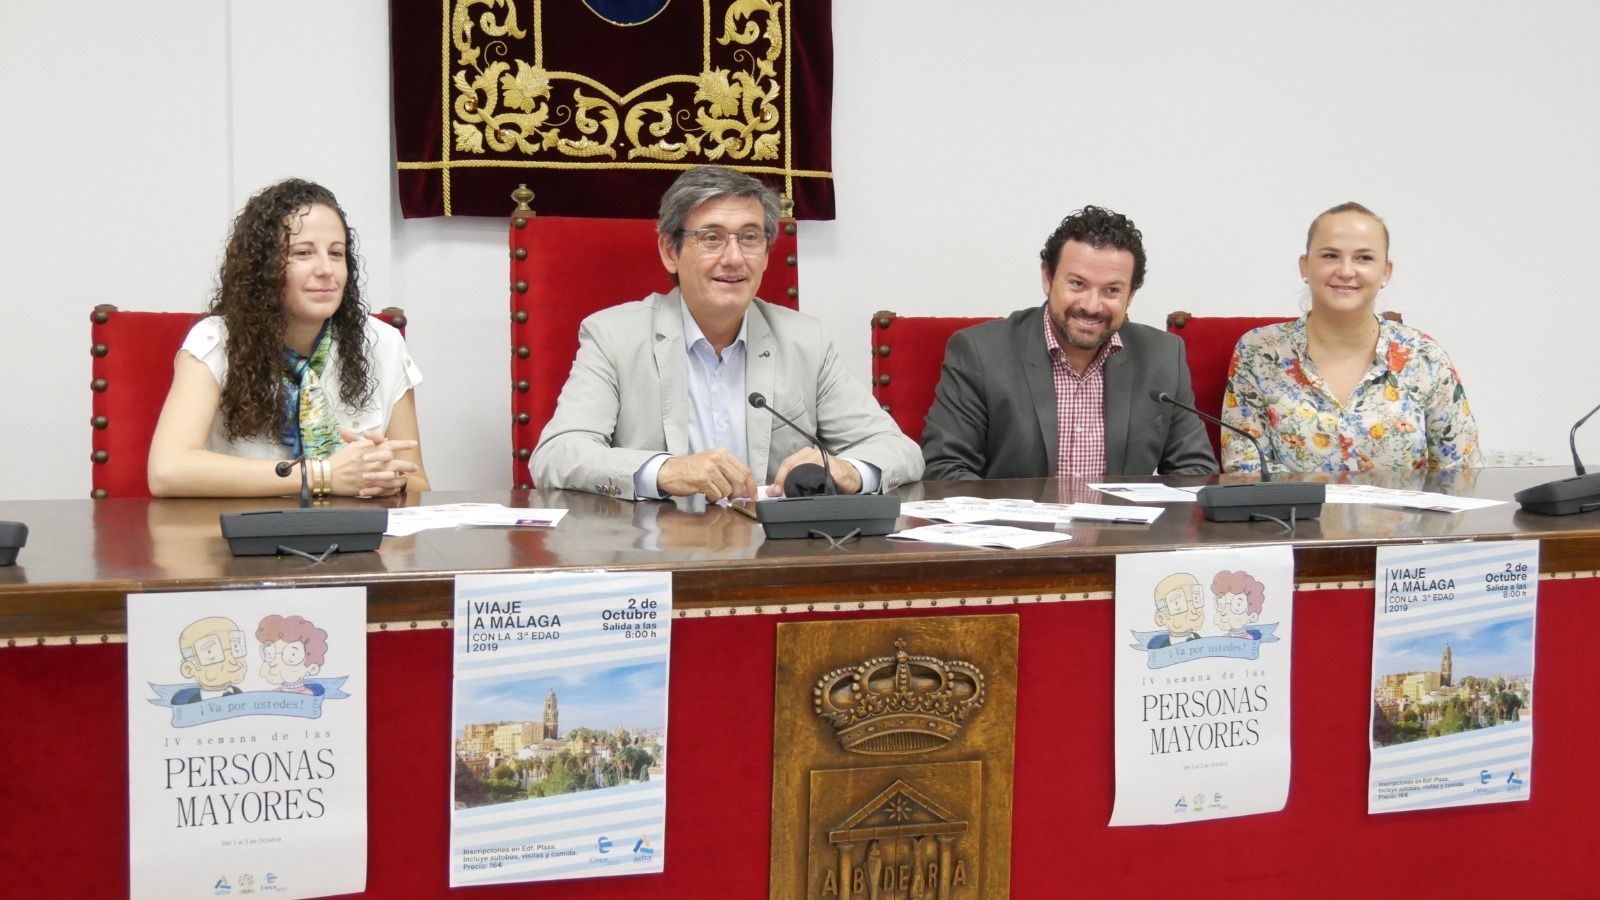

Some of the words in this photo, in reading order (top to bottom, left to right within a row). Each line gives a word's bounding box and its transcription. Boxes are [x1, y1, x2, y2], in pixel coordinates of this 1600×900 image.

[1391, 567, 1426, 580] VIAJE
[1505, 562, 1512, 573] 2
[1515, 563, 1528, 572] de
[1485, 572, 1527, 583] Octubre
[1390, 582, 1399, 593] A
[1402, 577, 1455, 593] MÁLAGA
[1486, 584, 1509, 592] Salida
[1389, 596, 1406, 604] CON
[1408, 595, 1418, 603] LA
[1432, 592, 1455, 601] EDAD
[1503, 591, 1521, 599] 8:00
[474, 600, 522, 615] VIAJE
[627, 598, 637, 610] 2
[640, 597, 657, 609] de
[1388, 604, 1408, 613] 2019
[473, 616, 485, 630] A
[490, 612, 561, 630] MÁLAGA
[601, 609, 657, 621] Octubre
[602, 622, 632, 631] Salida
[642, 621, 657, 630] las
[472, 632, 495, 642] CON
[498, 632, 511, 641] LA
[517, 632, 529, 641] 3ª
[531, 631, 560, 640] EDAD
[625, 630, 648, 639] 8:00
[650, 630, 657, 638] h
[472, 642, 499, 652] 2019
[1189, 645, 1204, 656] por
[1166, 674, 1211, 684] semana
[1221, 671, 1235, 680] de
[1245, 669, 1265, 678] las
[228, 702, 247, 713] por
[254, 698, 304, 710] ustedes!
[1142, 684, 1268, 722] PERSONAS
[164, 738, 181, 748] IV
[197, 736, 256, 746] semana
[271, 732, 289, 741] de
[305, 730, 331, 739] las
[1150, 718, 1259, 756] MAYORES
[164, 748, 335, 790] PERSONAS
[176, 787, 325, 828] MAYORES
[463, 847, 510, 856] Inscripciones
[463, 855, 489, 864] Incluye
[463, 863, 488, 871] Precio:
[821, 859, 967, 897] ABDERA
